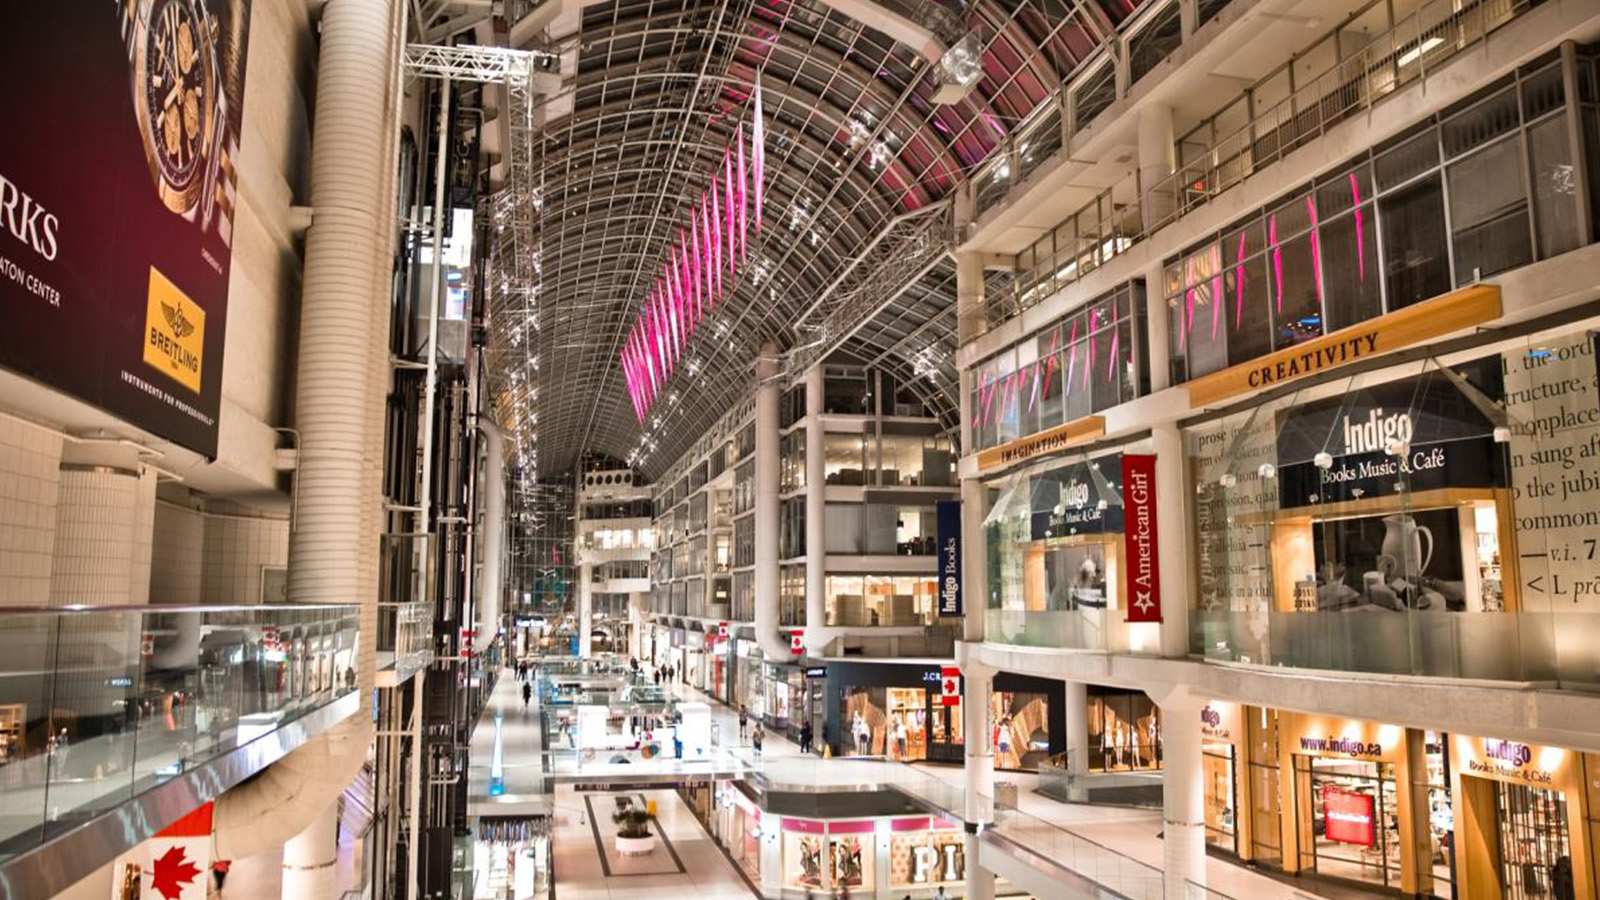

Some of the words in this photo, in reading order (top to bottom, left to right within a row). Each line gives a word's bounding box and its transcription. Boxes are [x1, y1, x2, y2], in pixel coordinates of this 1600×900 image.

[26, 274, 60, 307] CENTER
[150, 327, 198, 373] BREITLING
[1248, 331, 1378, 389] CREATIVITY
[1001, 431, 1067, 463] IMAGINATION
[1198, 432, 1226, 452] prose
[1343, 407, 1412, 456] Indigo
[1321, 463, 1356, 484] Books
[1359, 458, 1397, 480] Music
[1400, 457, 1414, 474] &
[1413, 448, 1445, 471] Café
[1530, 447, 1575, 470] sung
[1059, 478, 1088, 510] Indigo
[1527, 475, 1555, 499] the
[944, 537, 956, 573] Books
[942, 577, 959, 612] Indigo
[1553, 574, 1567, 594] L
[1300, 736, 1382, 757] www.indigo.ca
[1470, 759, 1493, 773] Books
